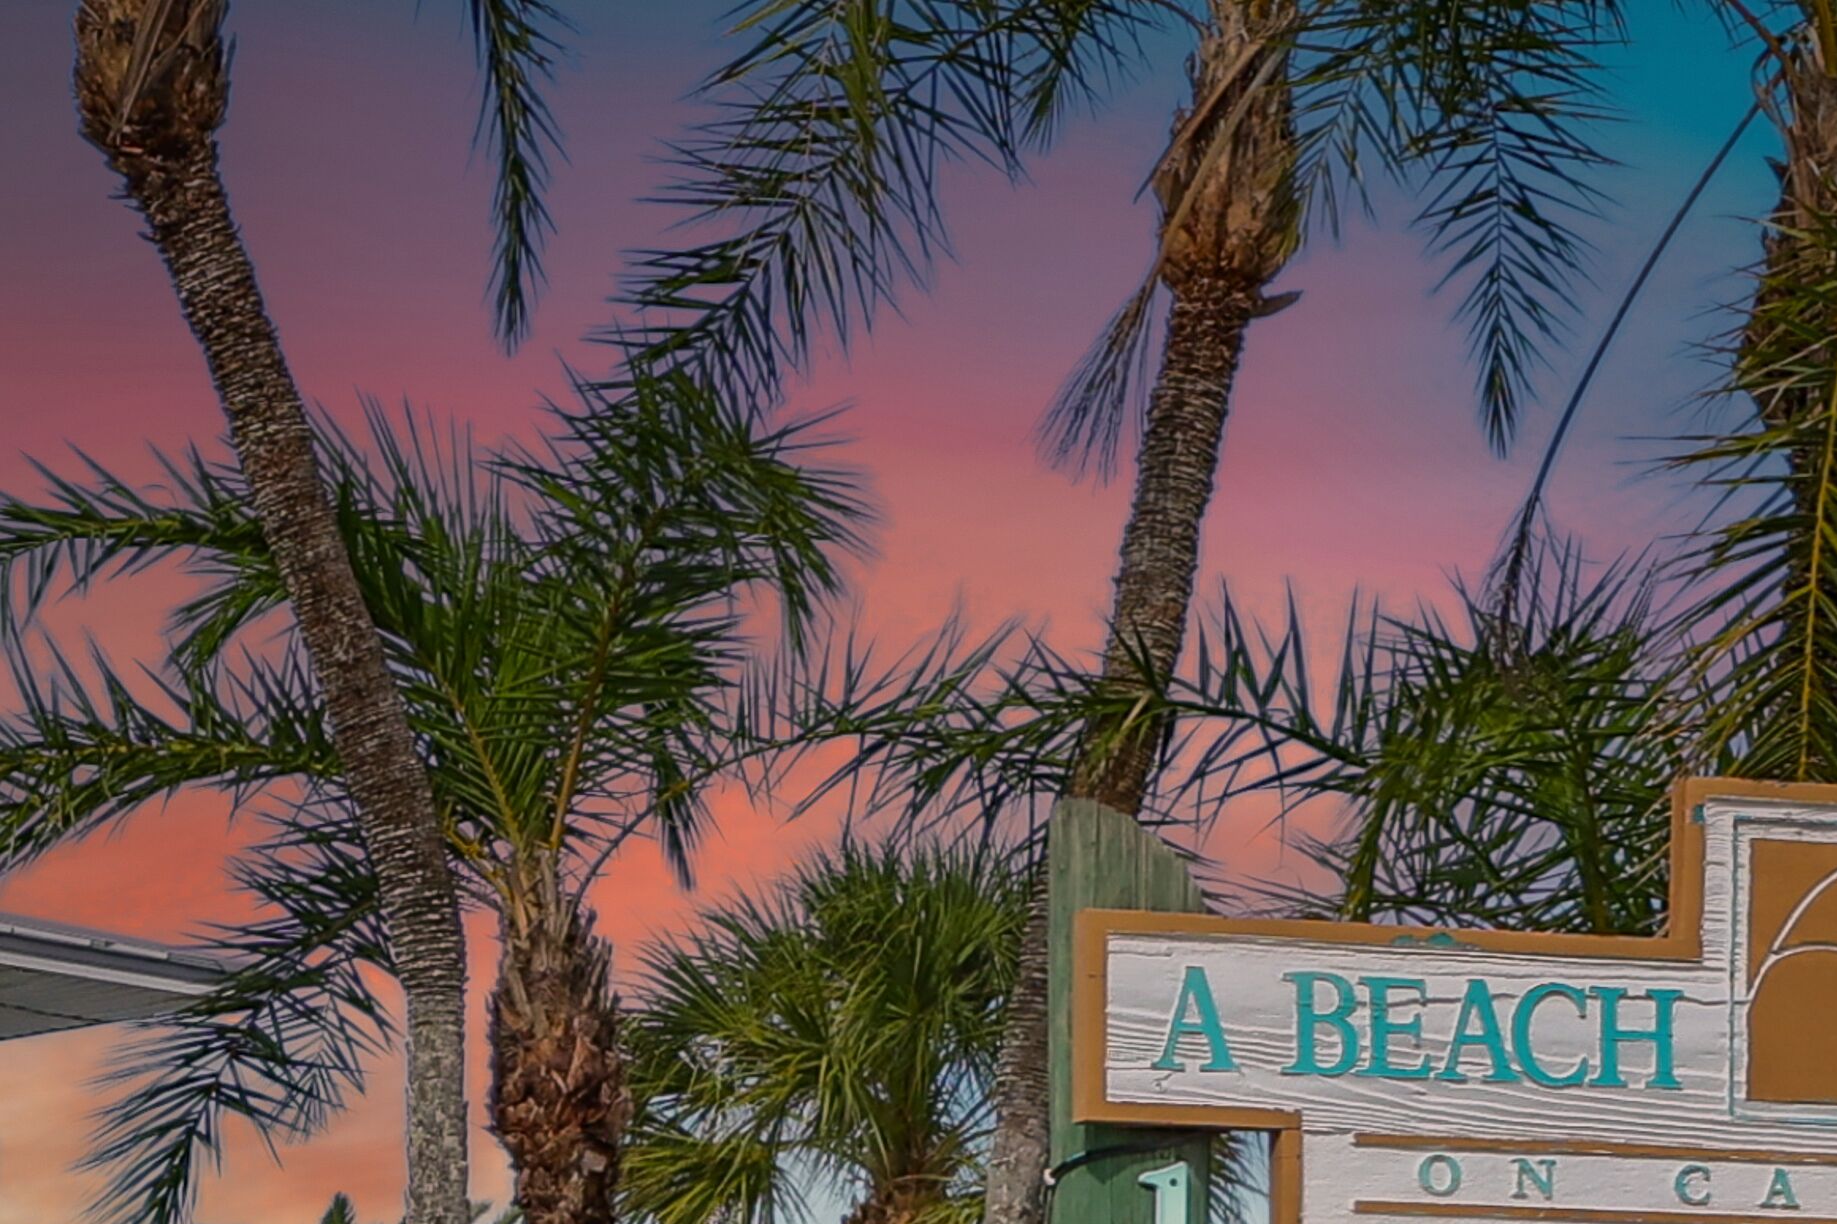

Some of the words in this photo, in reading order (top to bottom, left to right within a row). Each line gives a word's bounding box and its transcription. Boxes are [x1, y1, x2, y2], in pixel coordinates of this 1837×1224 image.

[1151, 966, 1242, 1072] A
[1280, 970, 1685, 1091] BEACH
[1417, 1154, 1556, 1200] ON
